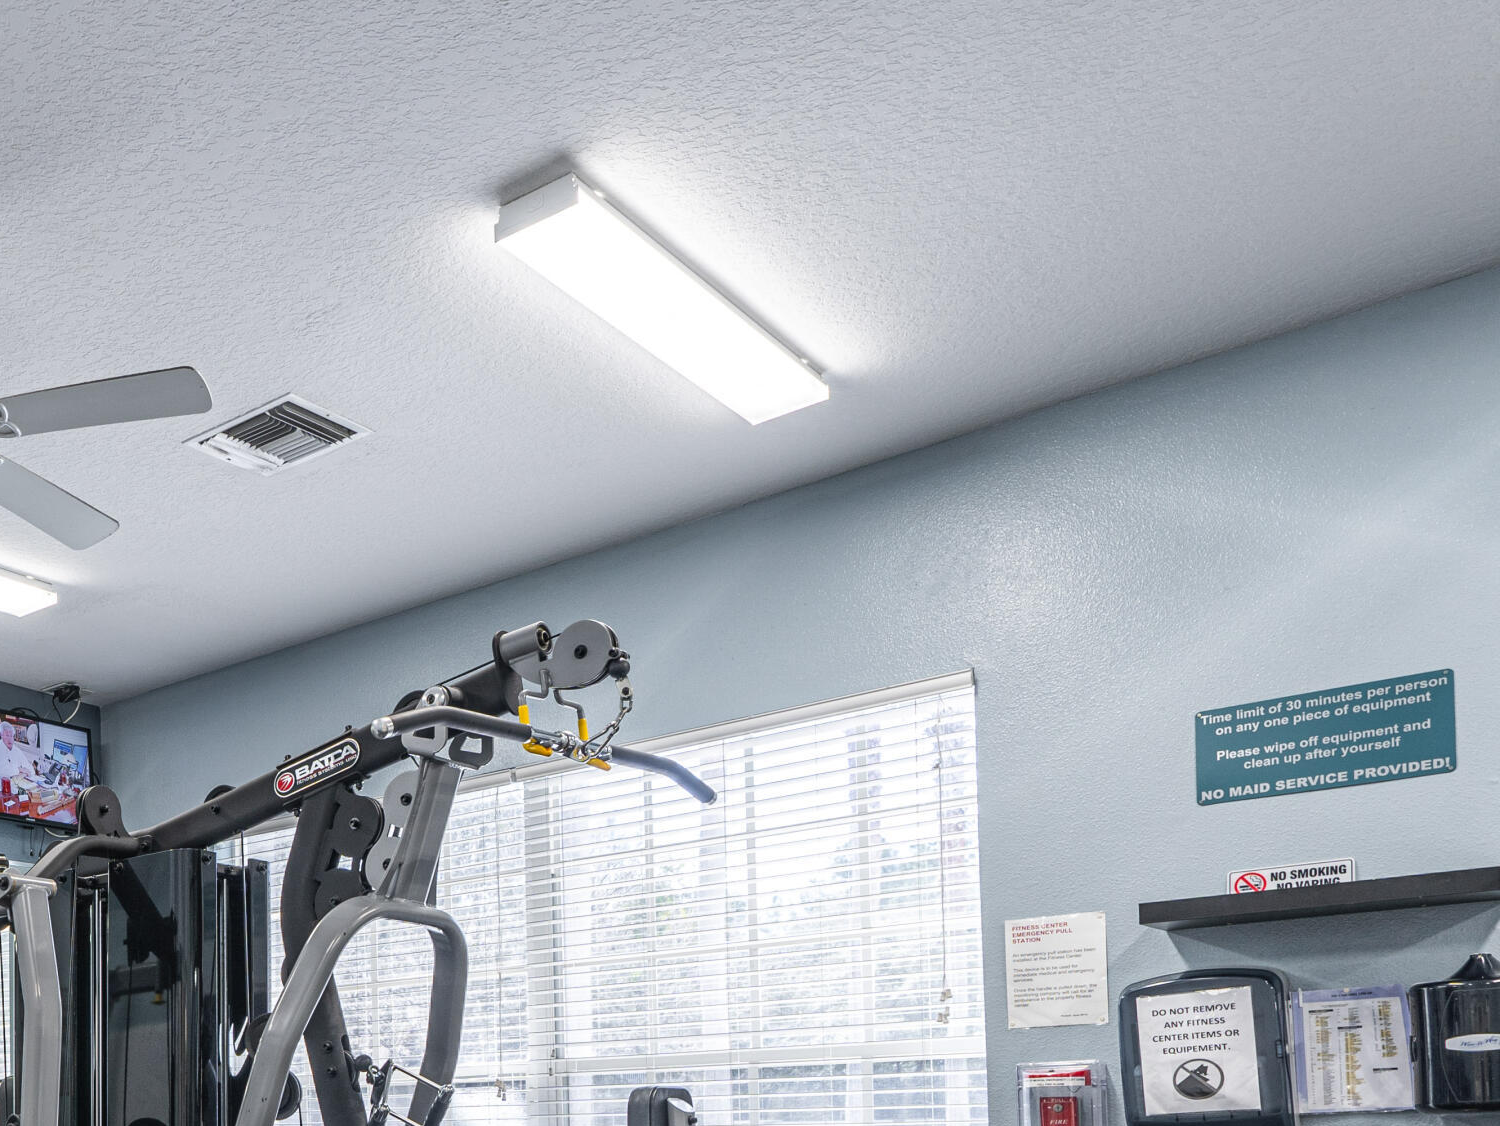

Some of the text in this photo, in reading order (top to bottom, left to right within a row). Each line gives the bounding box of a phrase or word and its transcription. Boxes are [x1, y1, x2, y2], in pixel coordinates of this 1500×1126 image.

[1201, 676, 1448, 725] Time limit of 30 minutes per person
[1215, 691, 1432, 736] on any one piece of equipment
[1216, 718, 1432, 761] Please wipe off equipment and
[1244, 736, 1402, 769] clean up after yourself
[294, 744, 357, 781] BATCA
[1201, 756, 1451, 802] NO MAID SERVICE PROVIDED!
[1270, 864, 1347, 881] NO SMOKING
[1276, 881, 1293, 889] NO
[1012, 930, 1054, 938] EMERGENCY
[1152, 1002, 1236, 1017] DO NOT REMOVE
[1163, 1017, 1226, 1028] ANY FITNESS
[1152, 1029, 1240, 1043] CENTER ITEMS OR
[1163, 1043, 1231, 1054] EQUIPEMENT.
